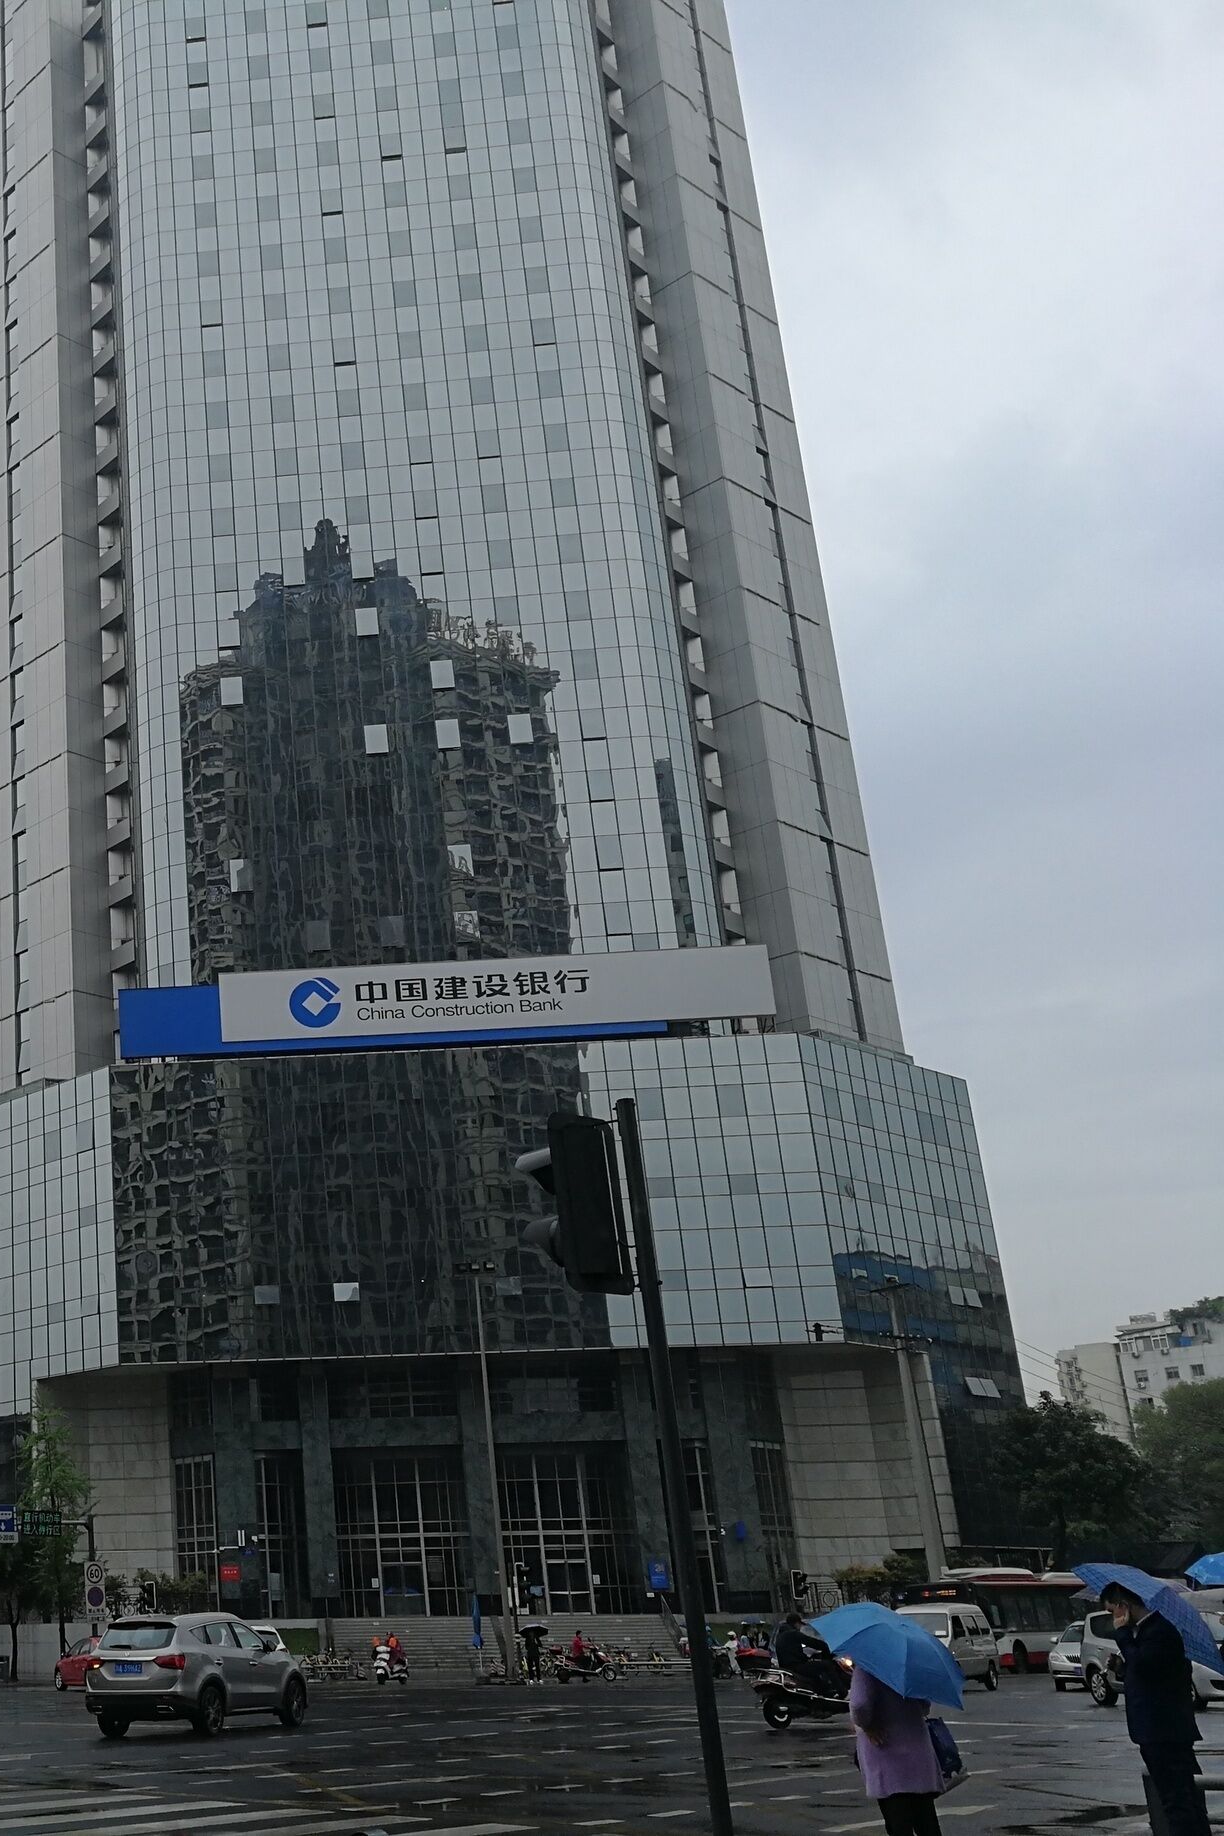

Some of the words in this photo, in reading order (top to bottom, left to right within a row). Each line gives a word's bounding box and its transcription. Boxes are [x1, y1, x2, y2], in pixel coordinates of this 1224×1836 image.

[355, 969, 590, 1003] 中国建设银行
[357, 1006, 405, 1021] China
[411, 1001, 514, 1018] Construction
[520, 998, 563, 1013] Bank
[90, 1569, 99, 1578] 60
